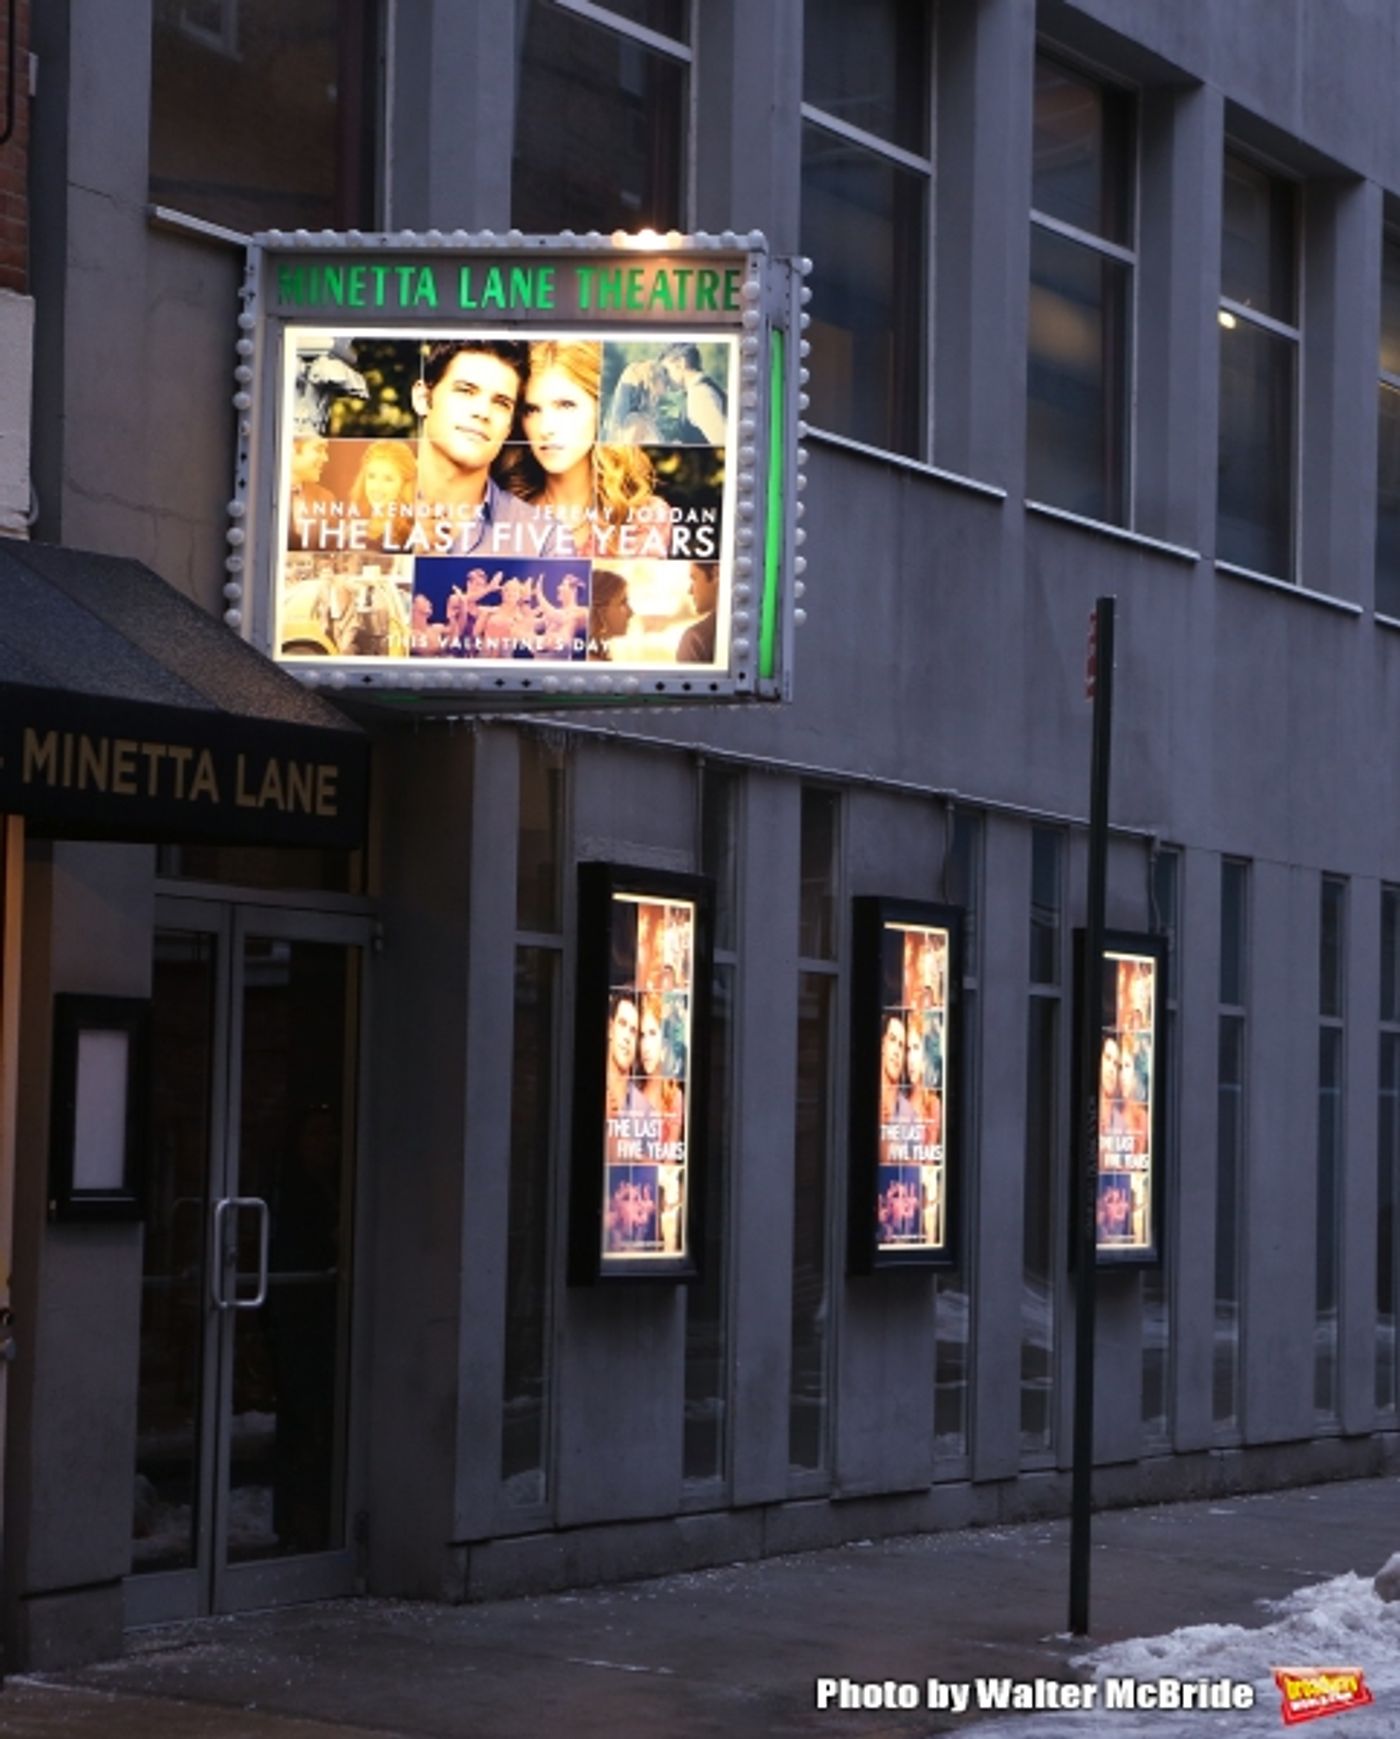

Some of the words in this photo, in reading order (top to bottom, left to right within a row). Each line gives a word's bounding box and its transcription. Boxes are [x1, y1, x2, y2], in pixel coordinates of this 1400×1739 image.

[278, 265, 438, 307] MINETTA
[460, 266, 554, 309] LANE
[576, 267, 742, 311] THEATRE
[298, 502, 362, 517] ANNA
[626, 507, 717, 523] JORDAN
[299, 518, 368, 549] THE
[382, 520, 476, 552] LAST
[491, 522, 575, 554] FIVE
[591, 524, 716, 557] YEARS
[438, 636, 565, 651] VALENTINES
[573, 638, 612, 652] DAY
[22, 727, 220, 804] MINETTA
[236, 754, 338, 816] LANE
[607, 1119, 630, 1137] THE
[634, 1119, 664, 1138] LAST
